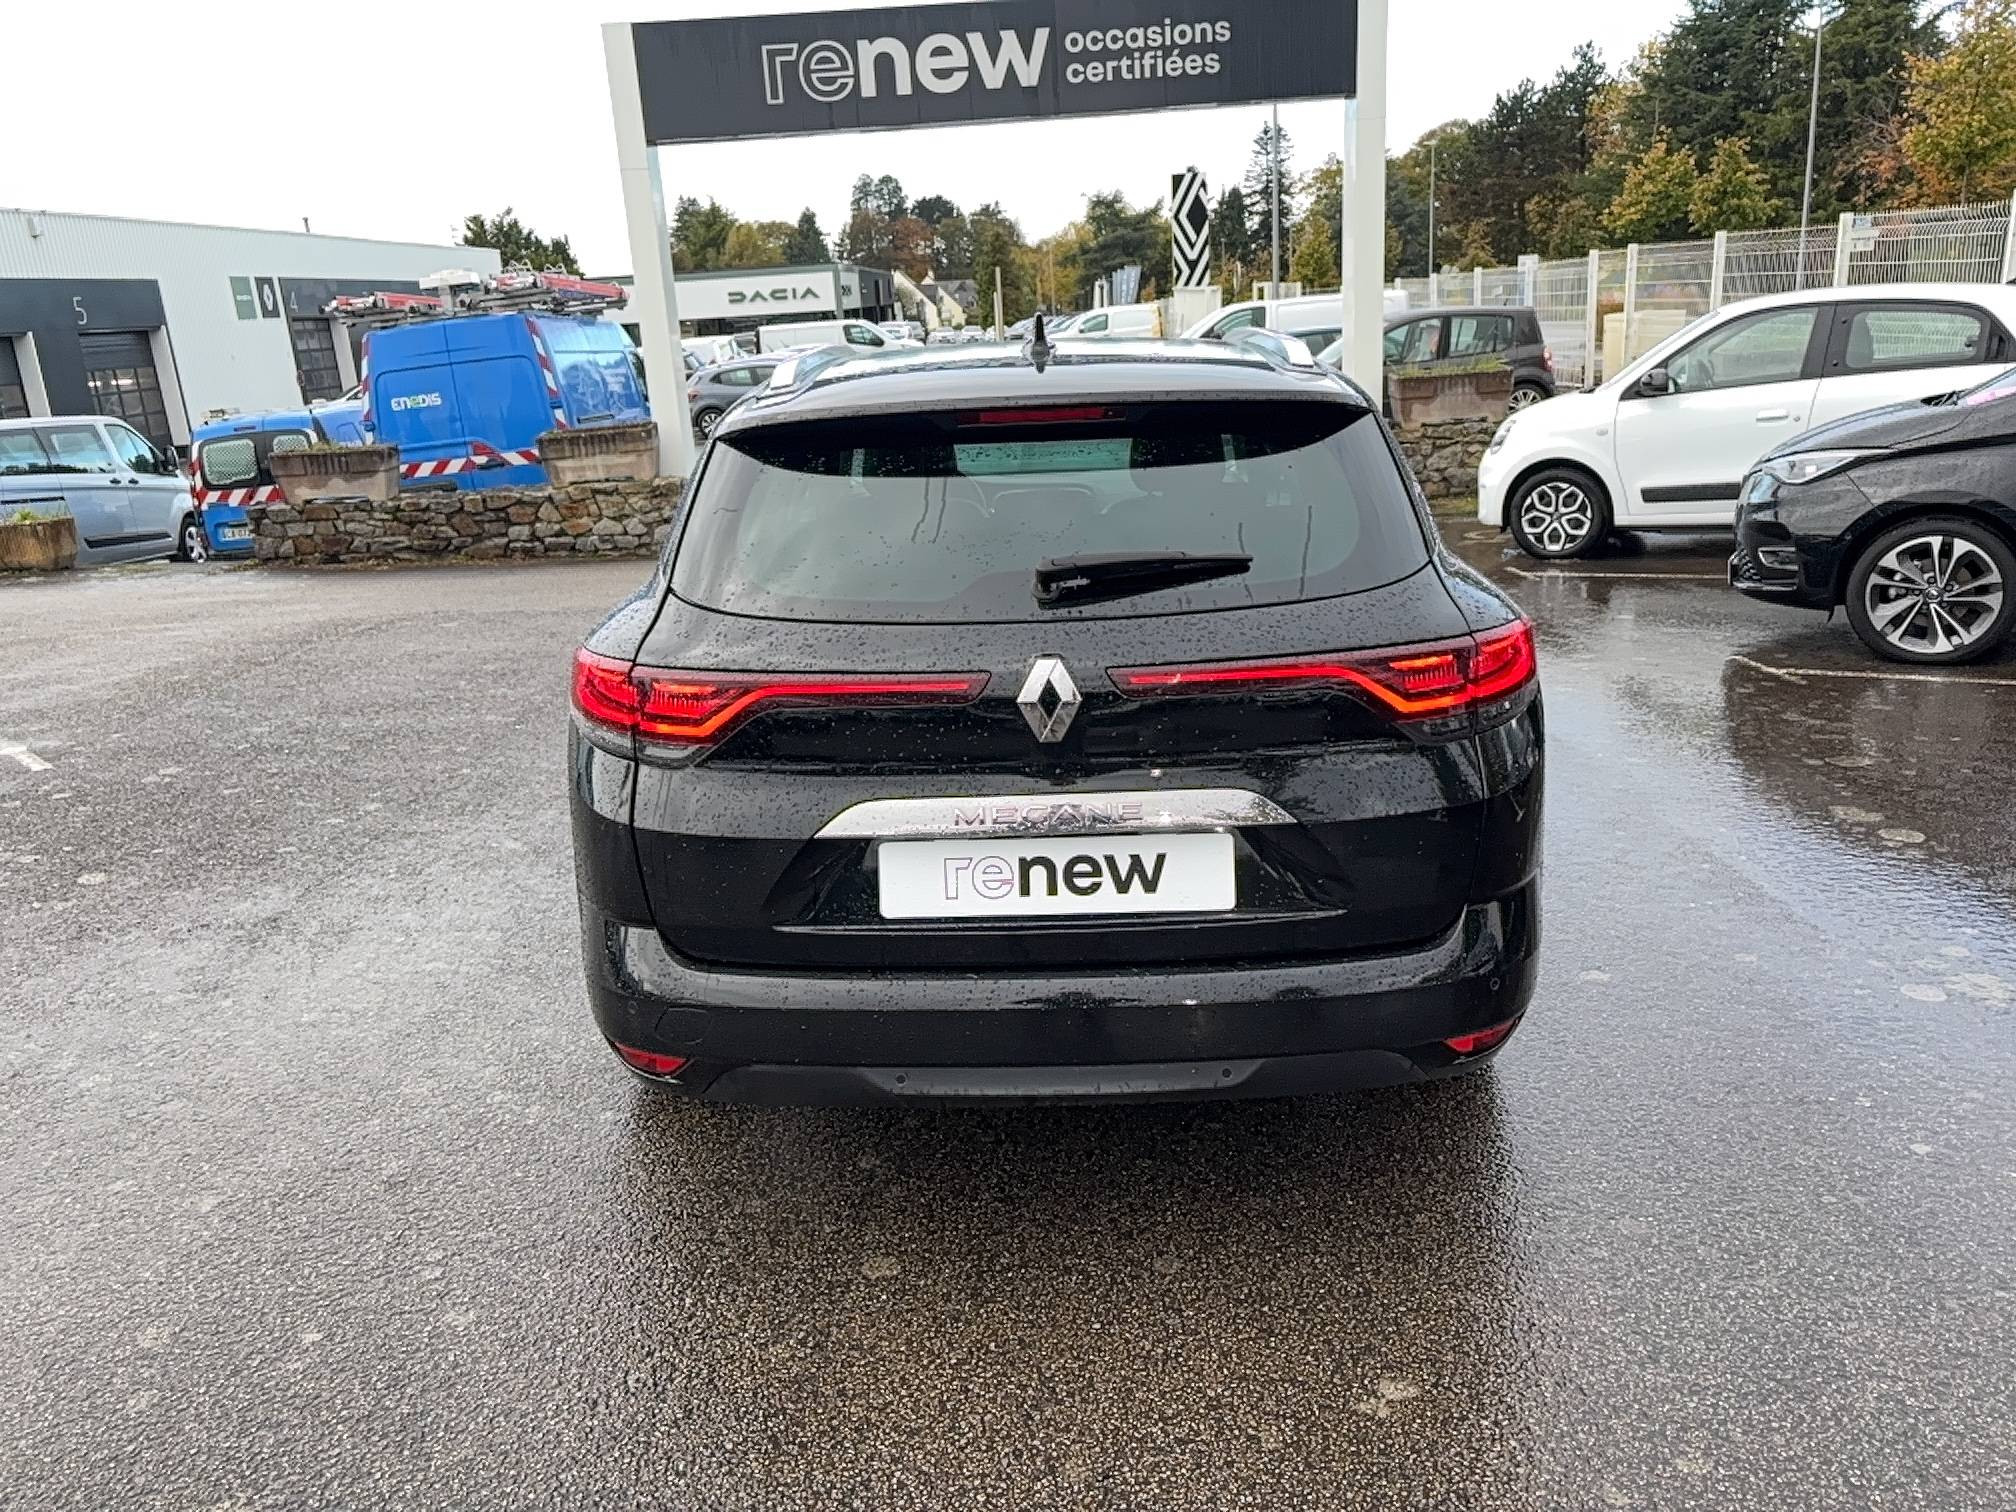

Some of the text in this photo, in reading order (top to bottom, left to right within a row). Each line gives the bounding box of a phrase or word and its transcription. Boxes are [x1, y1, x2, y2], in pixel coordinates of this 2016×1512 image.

[1064, 17, 1232, 54] occasions
[761, 27, 1051, 105] renew
[1066, 47, 1222, 84] certifiées
[72, 296, 88, 326] 5
[290, 291, 299, 313] 4
[728, 287, 820, 304] DACIA
[943, 851, 1168, 901] renew
